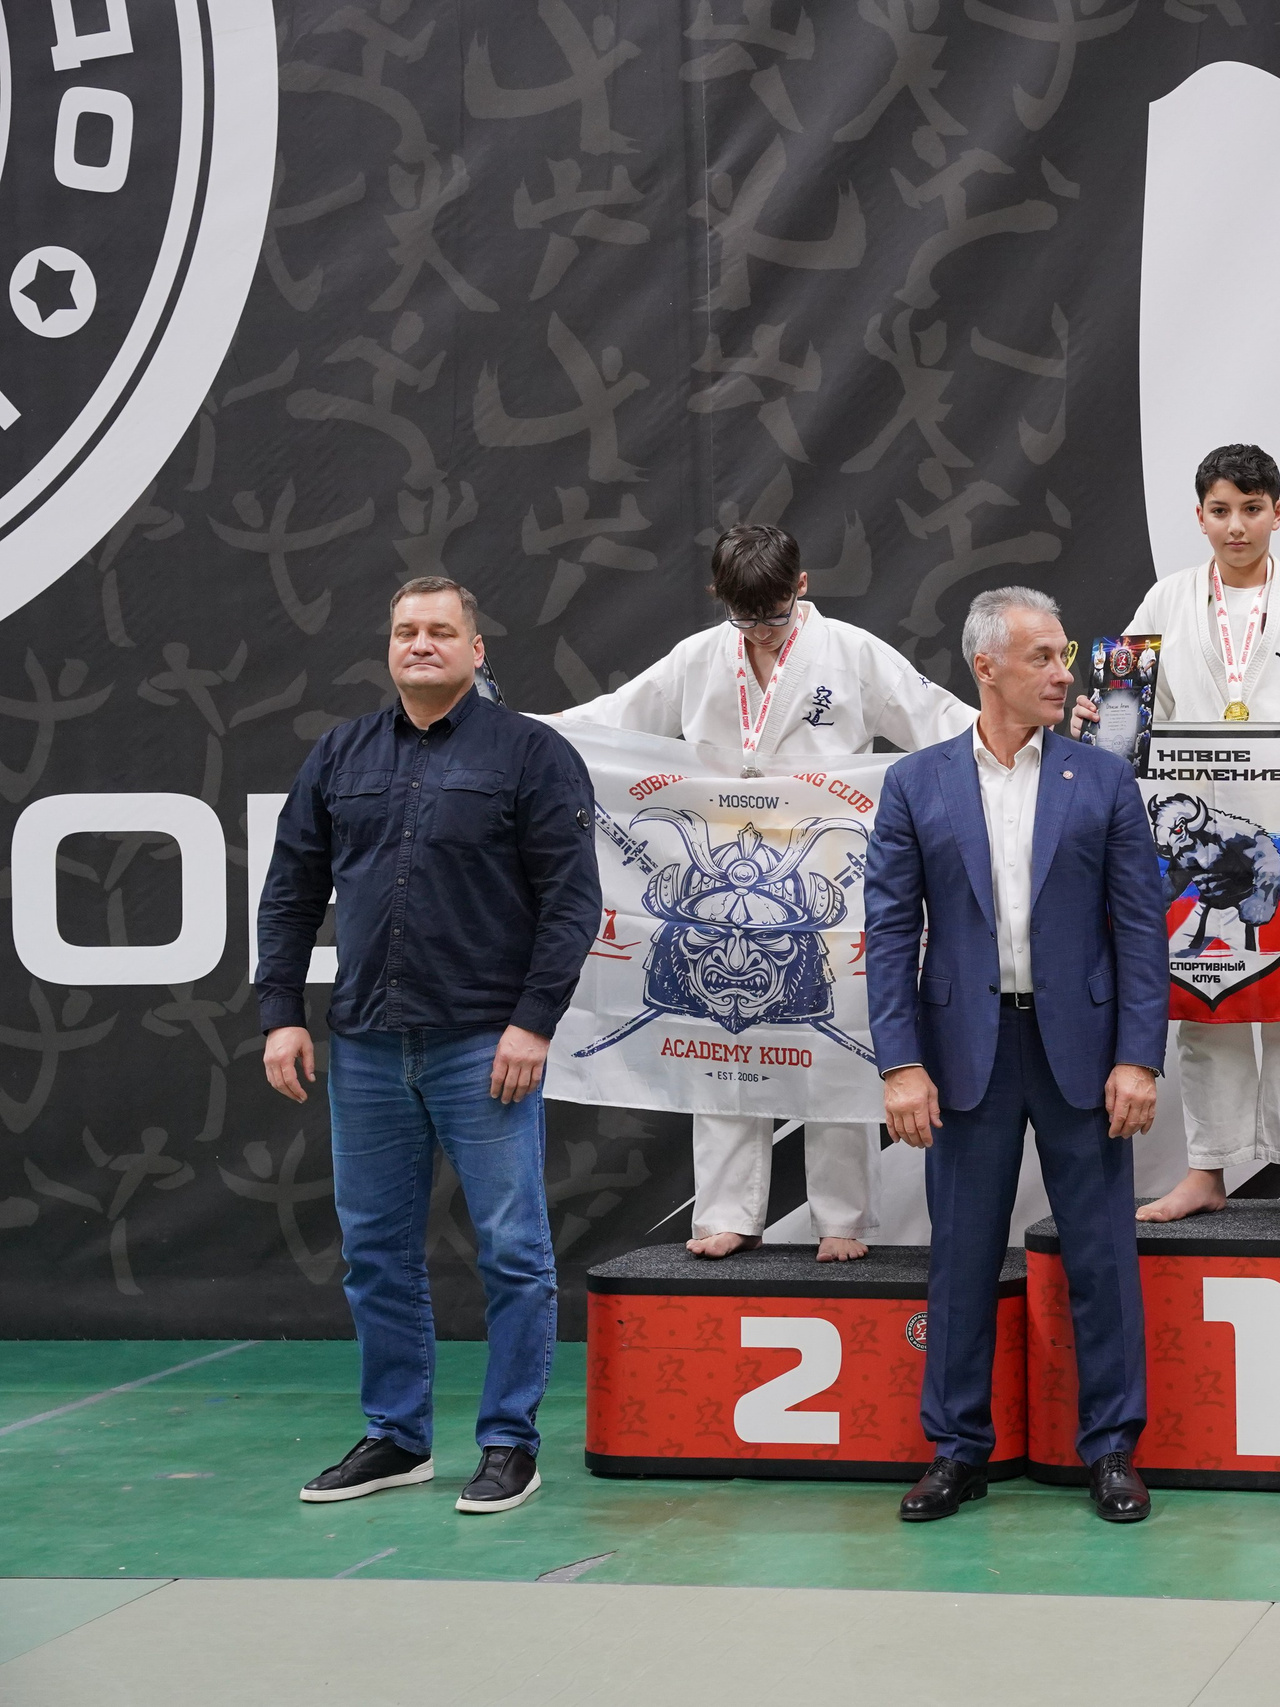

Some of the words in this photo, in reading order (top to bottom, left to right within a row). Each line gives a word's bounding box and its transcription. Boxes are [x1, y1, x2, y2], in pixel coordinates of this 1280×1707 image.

[777, 638, 793, 668] МОСКОВСКИЙ
[789, 626, 800, 641] СПОРТ
[740, 685, 750, 715] МОСКОВСКИЙ
[1156, 749, 1251, 762] НОВОЕ
[718, 794, 780, 810] MOSCOW
[827, 779, 874, 814] CLUB
[1170, 960, 1246, 972] СПОРТИВНЫЙ
[1192, 974, 1221, 984] КЛУБ
[660, 1037, 753, 1064] ACADEMY
[759, 1046, 813, 1068] KUDO
[733, 1316, 843, 1445] 2
